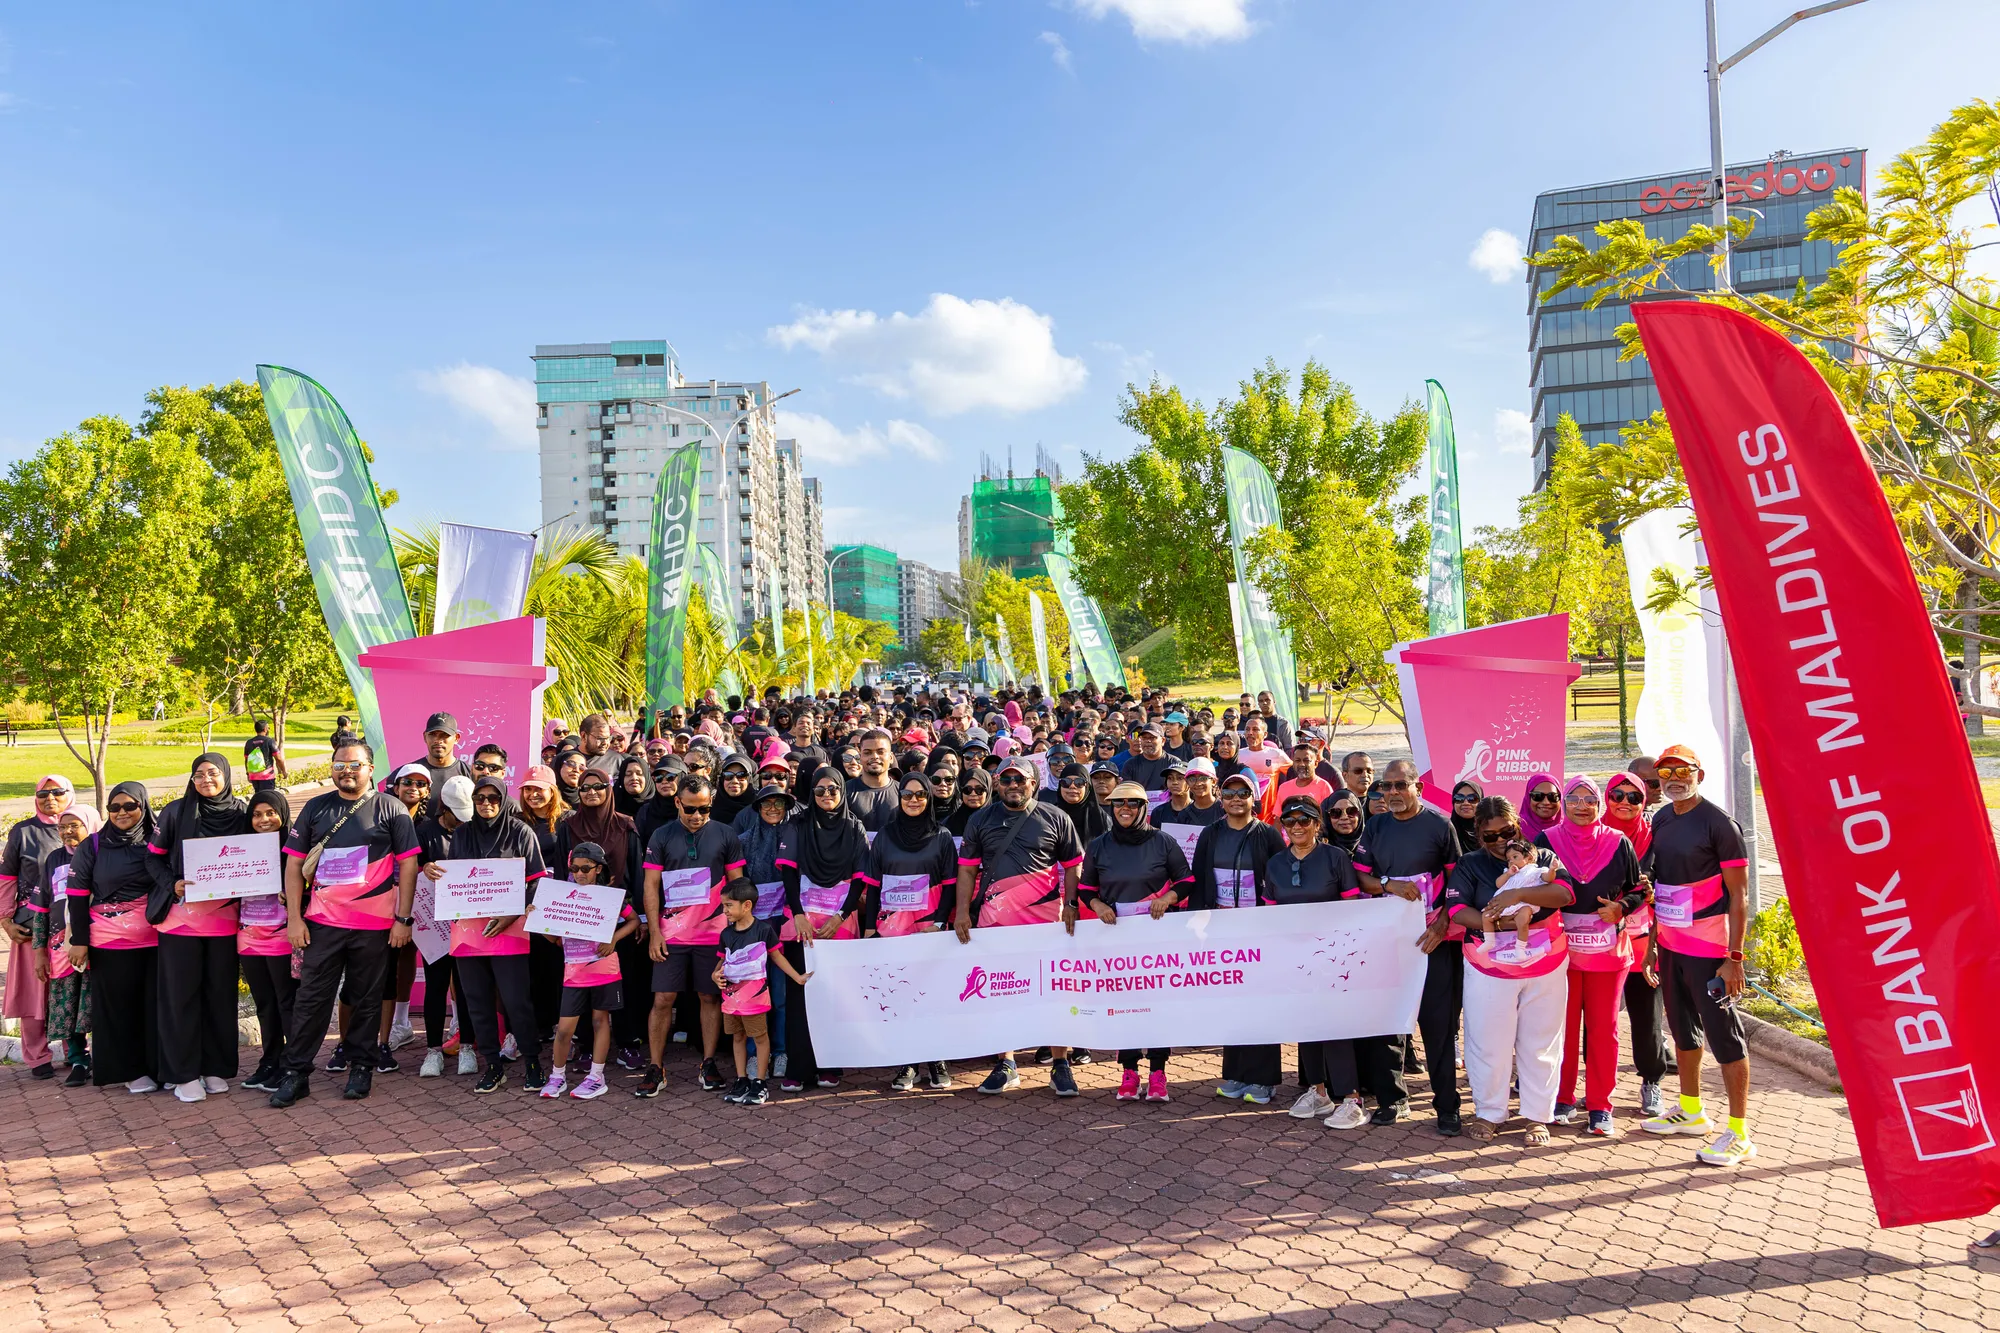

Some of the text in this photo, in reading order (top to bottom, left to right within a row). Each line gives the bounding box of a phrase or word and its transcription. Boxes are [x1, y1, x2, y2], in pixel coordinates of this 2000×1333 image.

[302, 443, 366, 565] HDC
[664, 494, 687, 577] HDC
[1063, 581, 1094, 629] HDC
[1738, 424, 1952, 1054] BANK OF MALDIVES
[1496, 750, 1531, 760] PINK
[1496, 762, 1550, 772] RIBBON
[349, 799, 365, 813] urban
[331, 816, 348, 832] urban
[890, 894, 915, 902] MARIE
[1222, 888, 1248, 898] MAIE
[544, 906, 578, 916] decreases
[575, 904, 600, 913] feeding
[575, 918, 600, 926] Cancer
[1568, 935, 1608, 943] NEENA
[1051, 948, 1261, 975] I CAN, YOU CAN, WE CAN
[990, 971, 1016, 981] PINK
[1051, 969, 1244, 992] HELP PREVENT CANCER
[990, 978, 1031, 990] RIBBON
